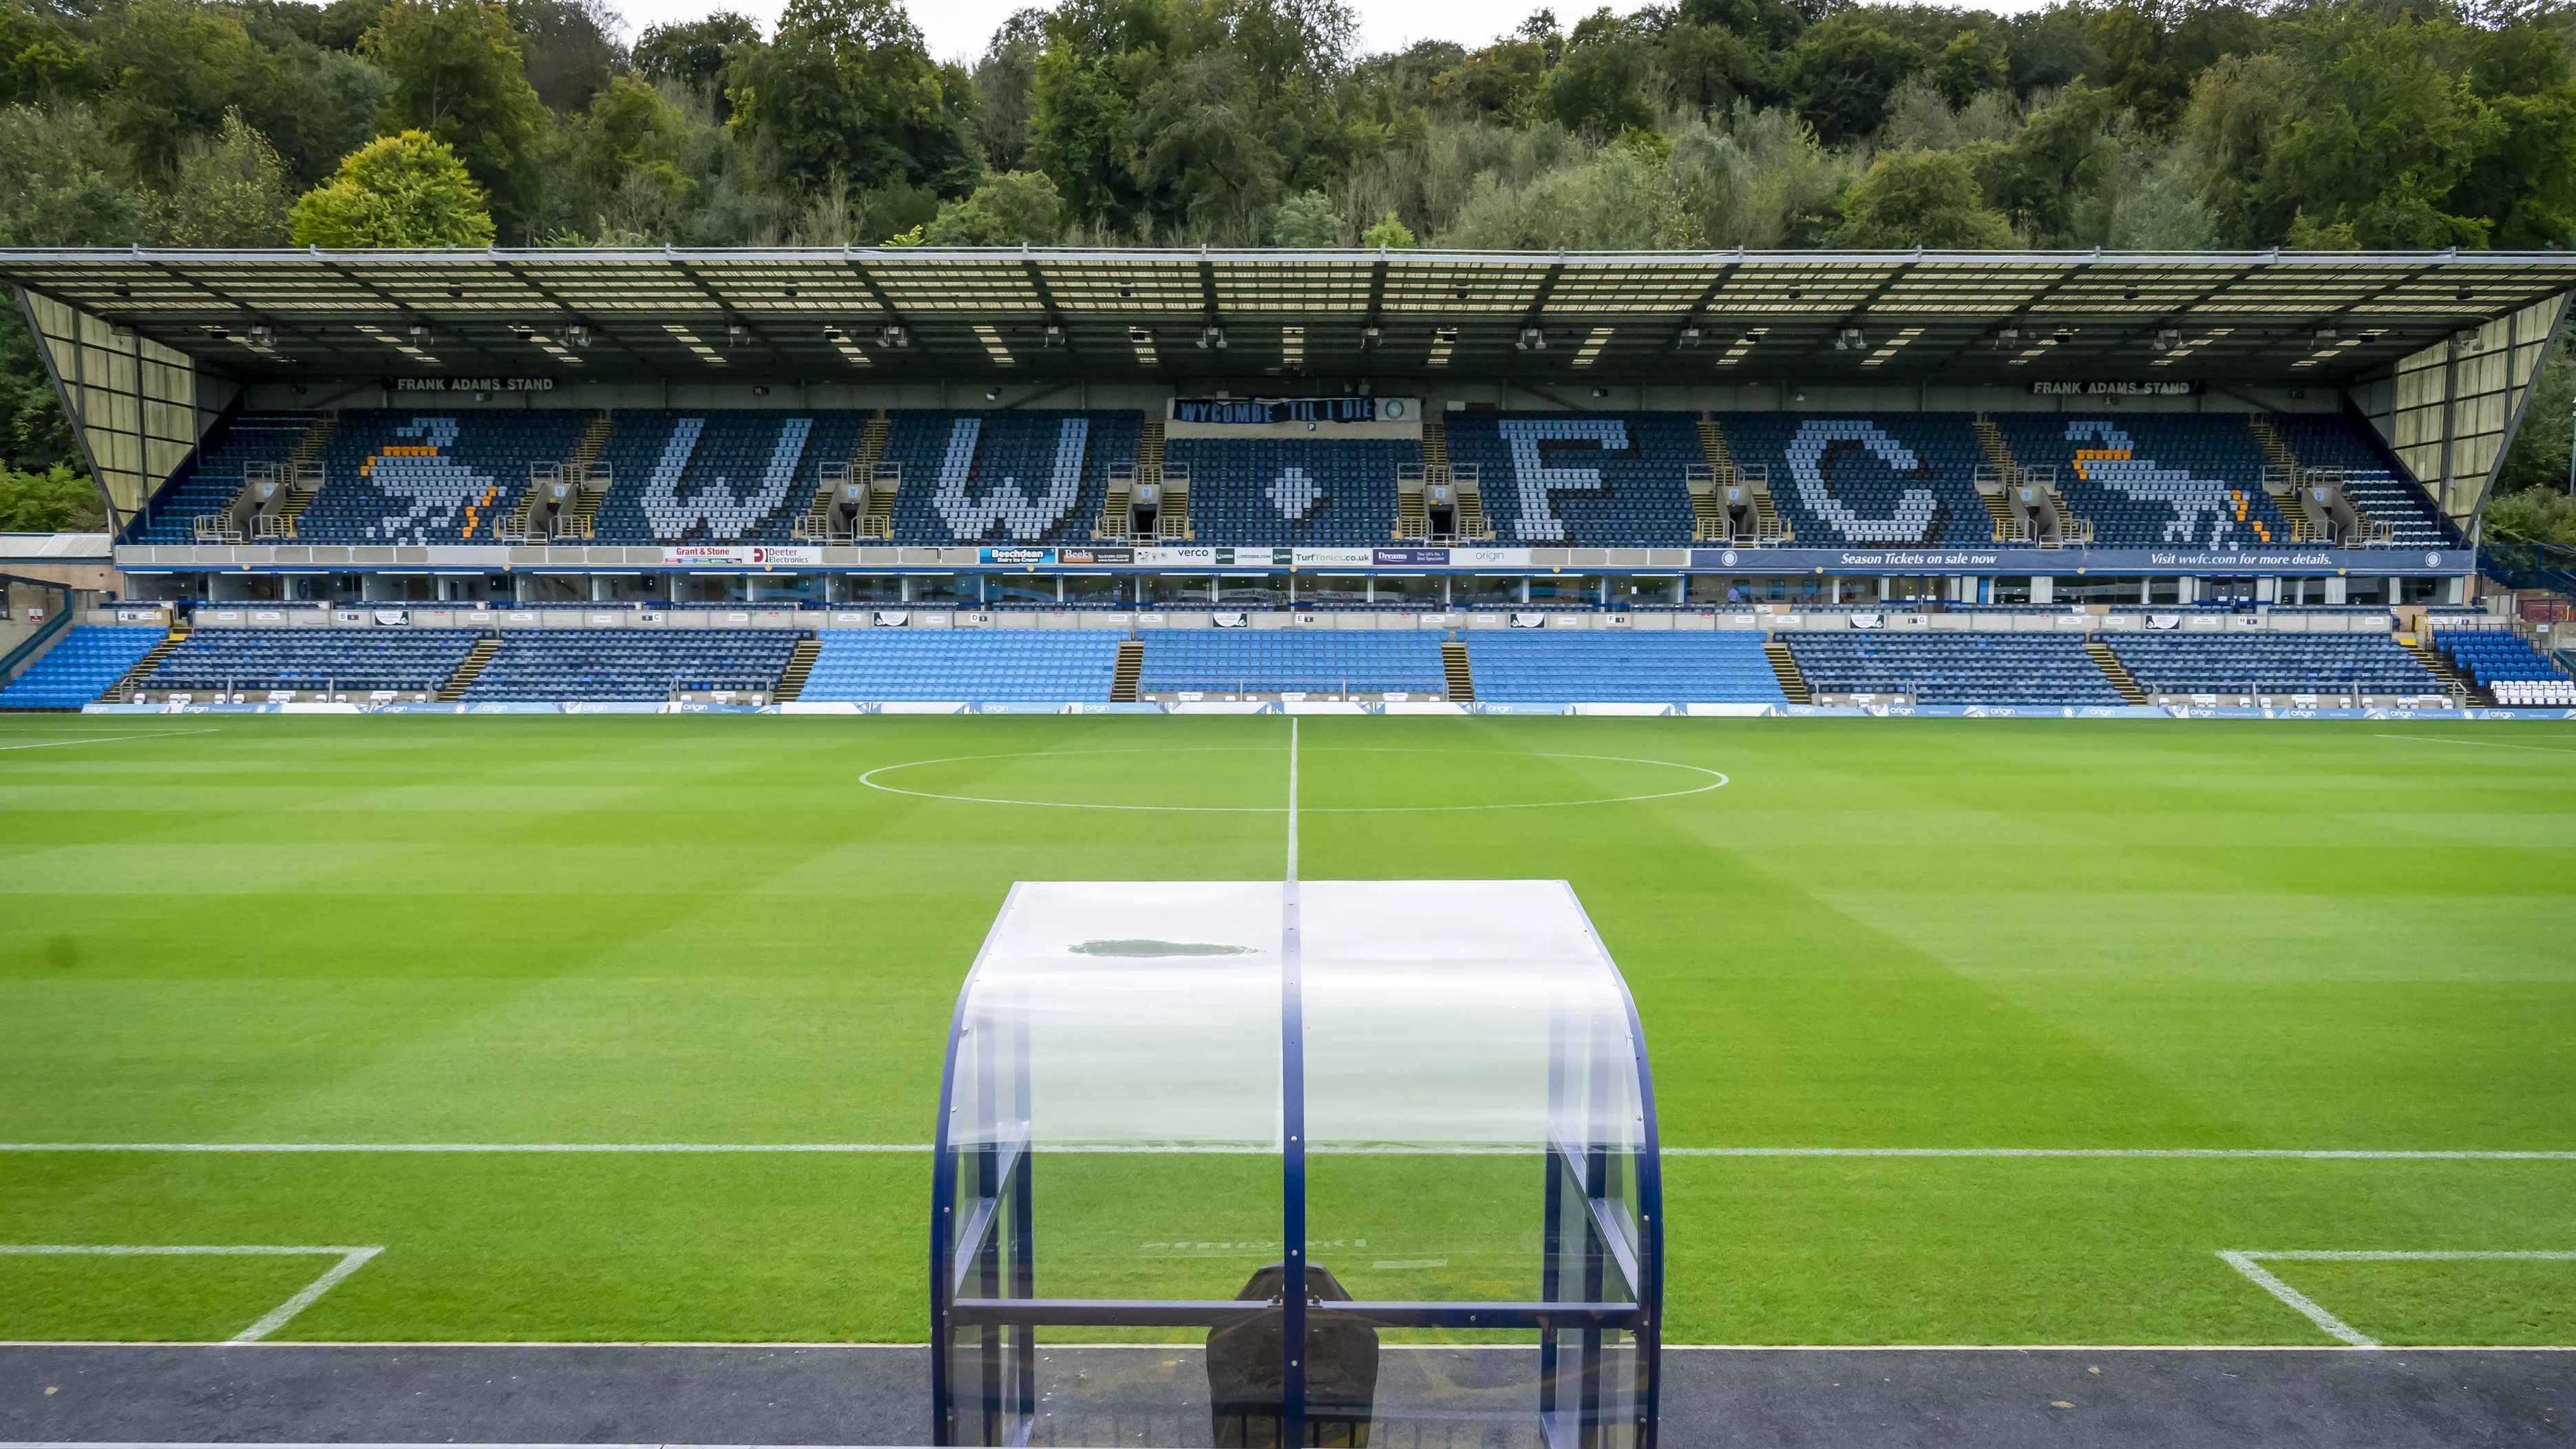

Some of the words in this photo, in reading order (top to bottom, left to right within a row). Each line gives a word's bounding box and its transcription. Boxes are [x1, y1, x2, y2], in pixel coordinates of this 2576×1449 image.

[397, 378, 445, 390] FRANK
[452, 379, 501, 390] ADAMS
[508, 378, 553, 390] STAND
[2034, 381, 2082, 394] FRANK
[2088, 382, 2137, 394] ADAMS
[2144, 382, 2190, 394] STAND
[1181, 402, 1274, 423] WYCOMBE
[1327, 400, 1333, 419] I
[1342, 399, 1373, 419] DIE
[677, 547, 698, 556] Grant
[707, 547, 730, 556] Stone
[769, 548, 798, 556] Deeter
[991, 549, 1044, 558] Beechdean
[1065, 549, 1093, 558] Beeks
[1378, 551, 1407, 560] Dreams
[1296, 553, 1369, 562] TurfTonics.co.uk
[1475, 551, 1504, 562] origin
[1841, 553, 1882, 564] Season
[1885, 553, 1924, 564] Tickets
[1927, 556, 1942, 564] on
[1945, 553, 1968, 564] sale
[1971, 555, 1996, 564] now
[2151, 553, 2175, 564] Visit
[2179, 553, 2236, 564] wwfc.com
[2239, 553, 2257, 564] for
[2259, 556, 2289, 565] more
[2292, 553, 2332, 565] details.
[383, 705, 408, 713] origin
[583, 704, 608, 713] origin
[683, 704, 708, 712] origin
[984, 704, 1009, 712] origin
[1084, 704, 1109, 712] origin
[1488, 704, 1513, 713] origin
[1790, 706, 1815, 715] origin
[1890, 707, 1914, 715] origin
[1990, 708, 2015, 716] origin
[2090, 708, 2115, 717] origin
[2190, 708, 2215, 717] origin
[2290, 709, 2316, 718] origin
[2390, 710, 2415, 719] origin
[2490, 710, 2515, 719] origin
